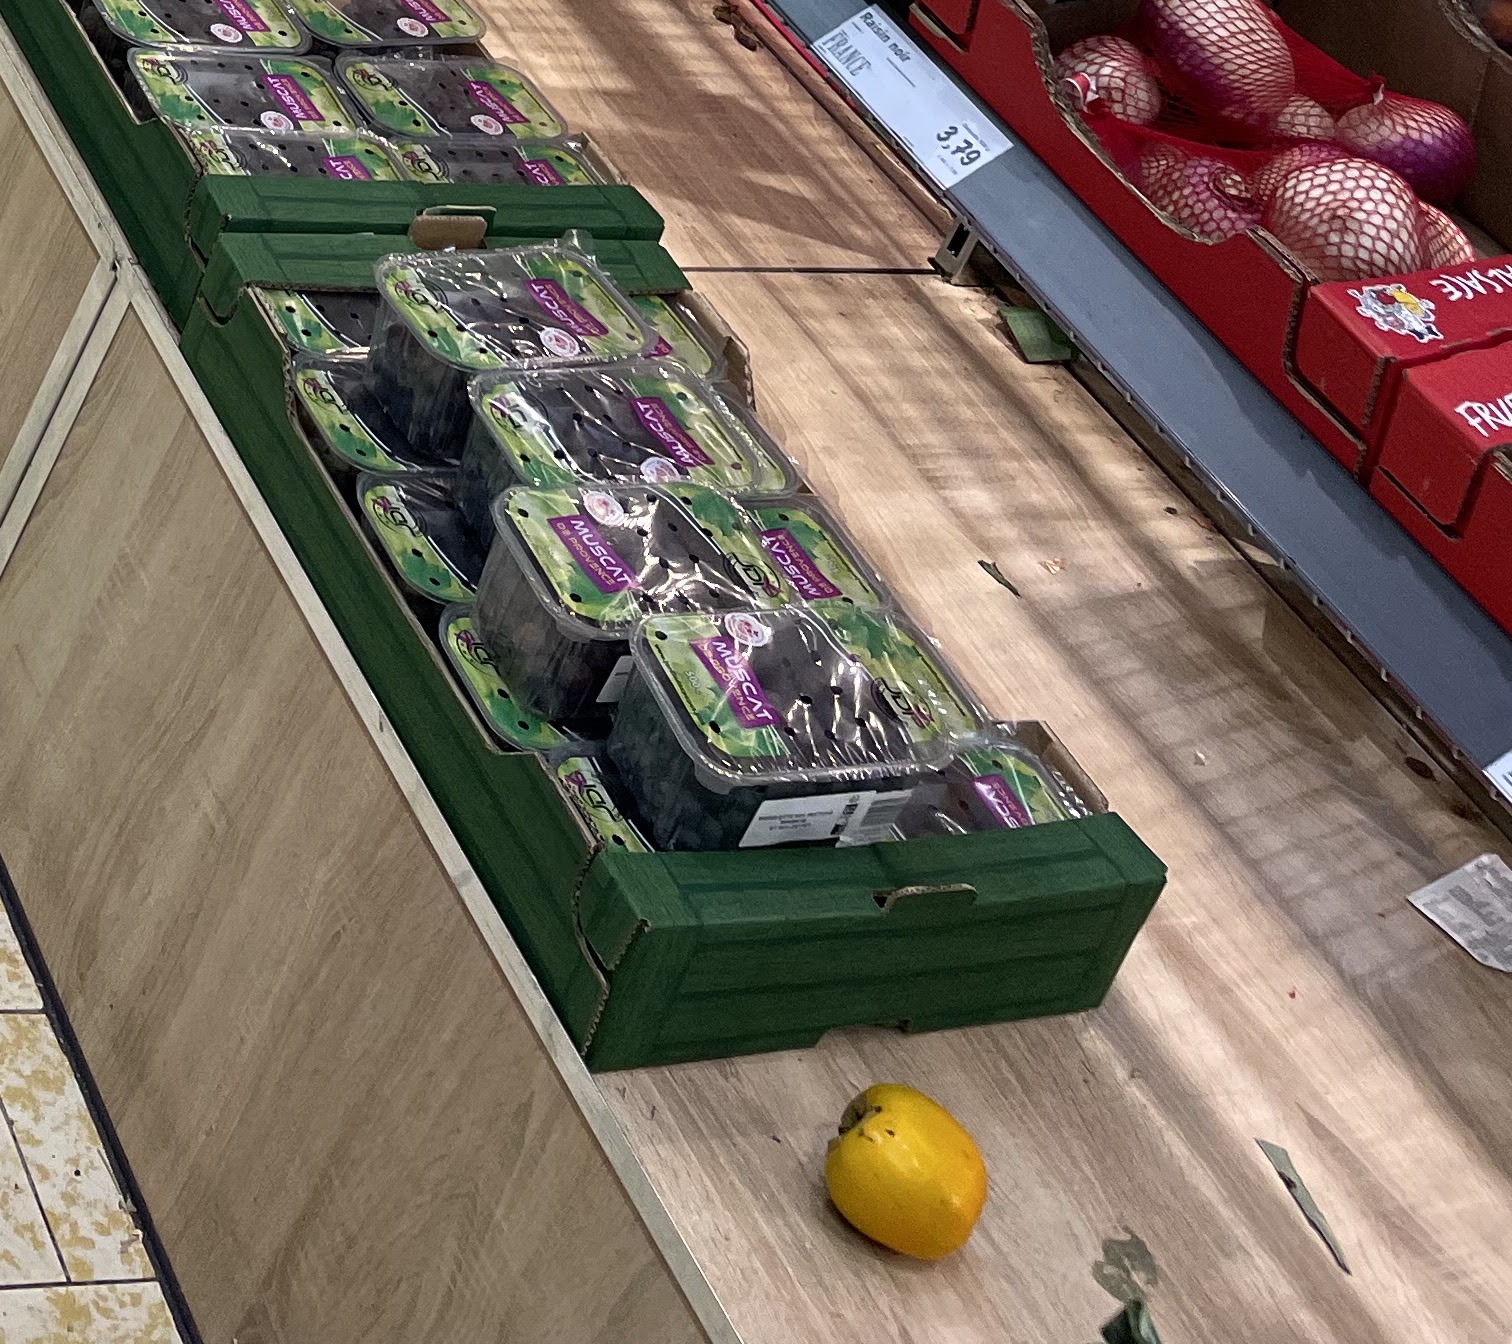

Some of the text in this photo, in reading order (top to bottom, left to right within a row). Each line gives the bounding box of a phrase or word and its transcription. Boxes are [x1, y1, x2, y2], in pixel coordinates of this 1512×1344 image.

[822, 28, 871, 79] FRANCE
[859, 10, 912, 65] Raisin noir
[267, 75, 308, 121] MUSCAT
[471, 80, 513, 123] MUSCAT
[935, 123, 981, 167] 3,79
[638, 400, 697, 466] MUSCAT
[556, 522, 617, 586] DE PROVENCE
[569, 518, 632, 585] MUSCAT
[762, 534, 824, 598] MUSCAT
[711, 640, 774, 722] MUSCAT
